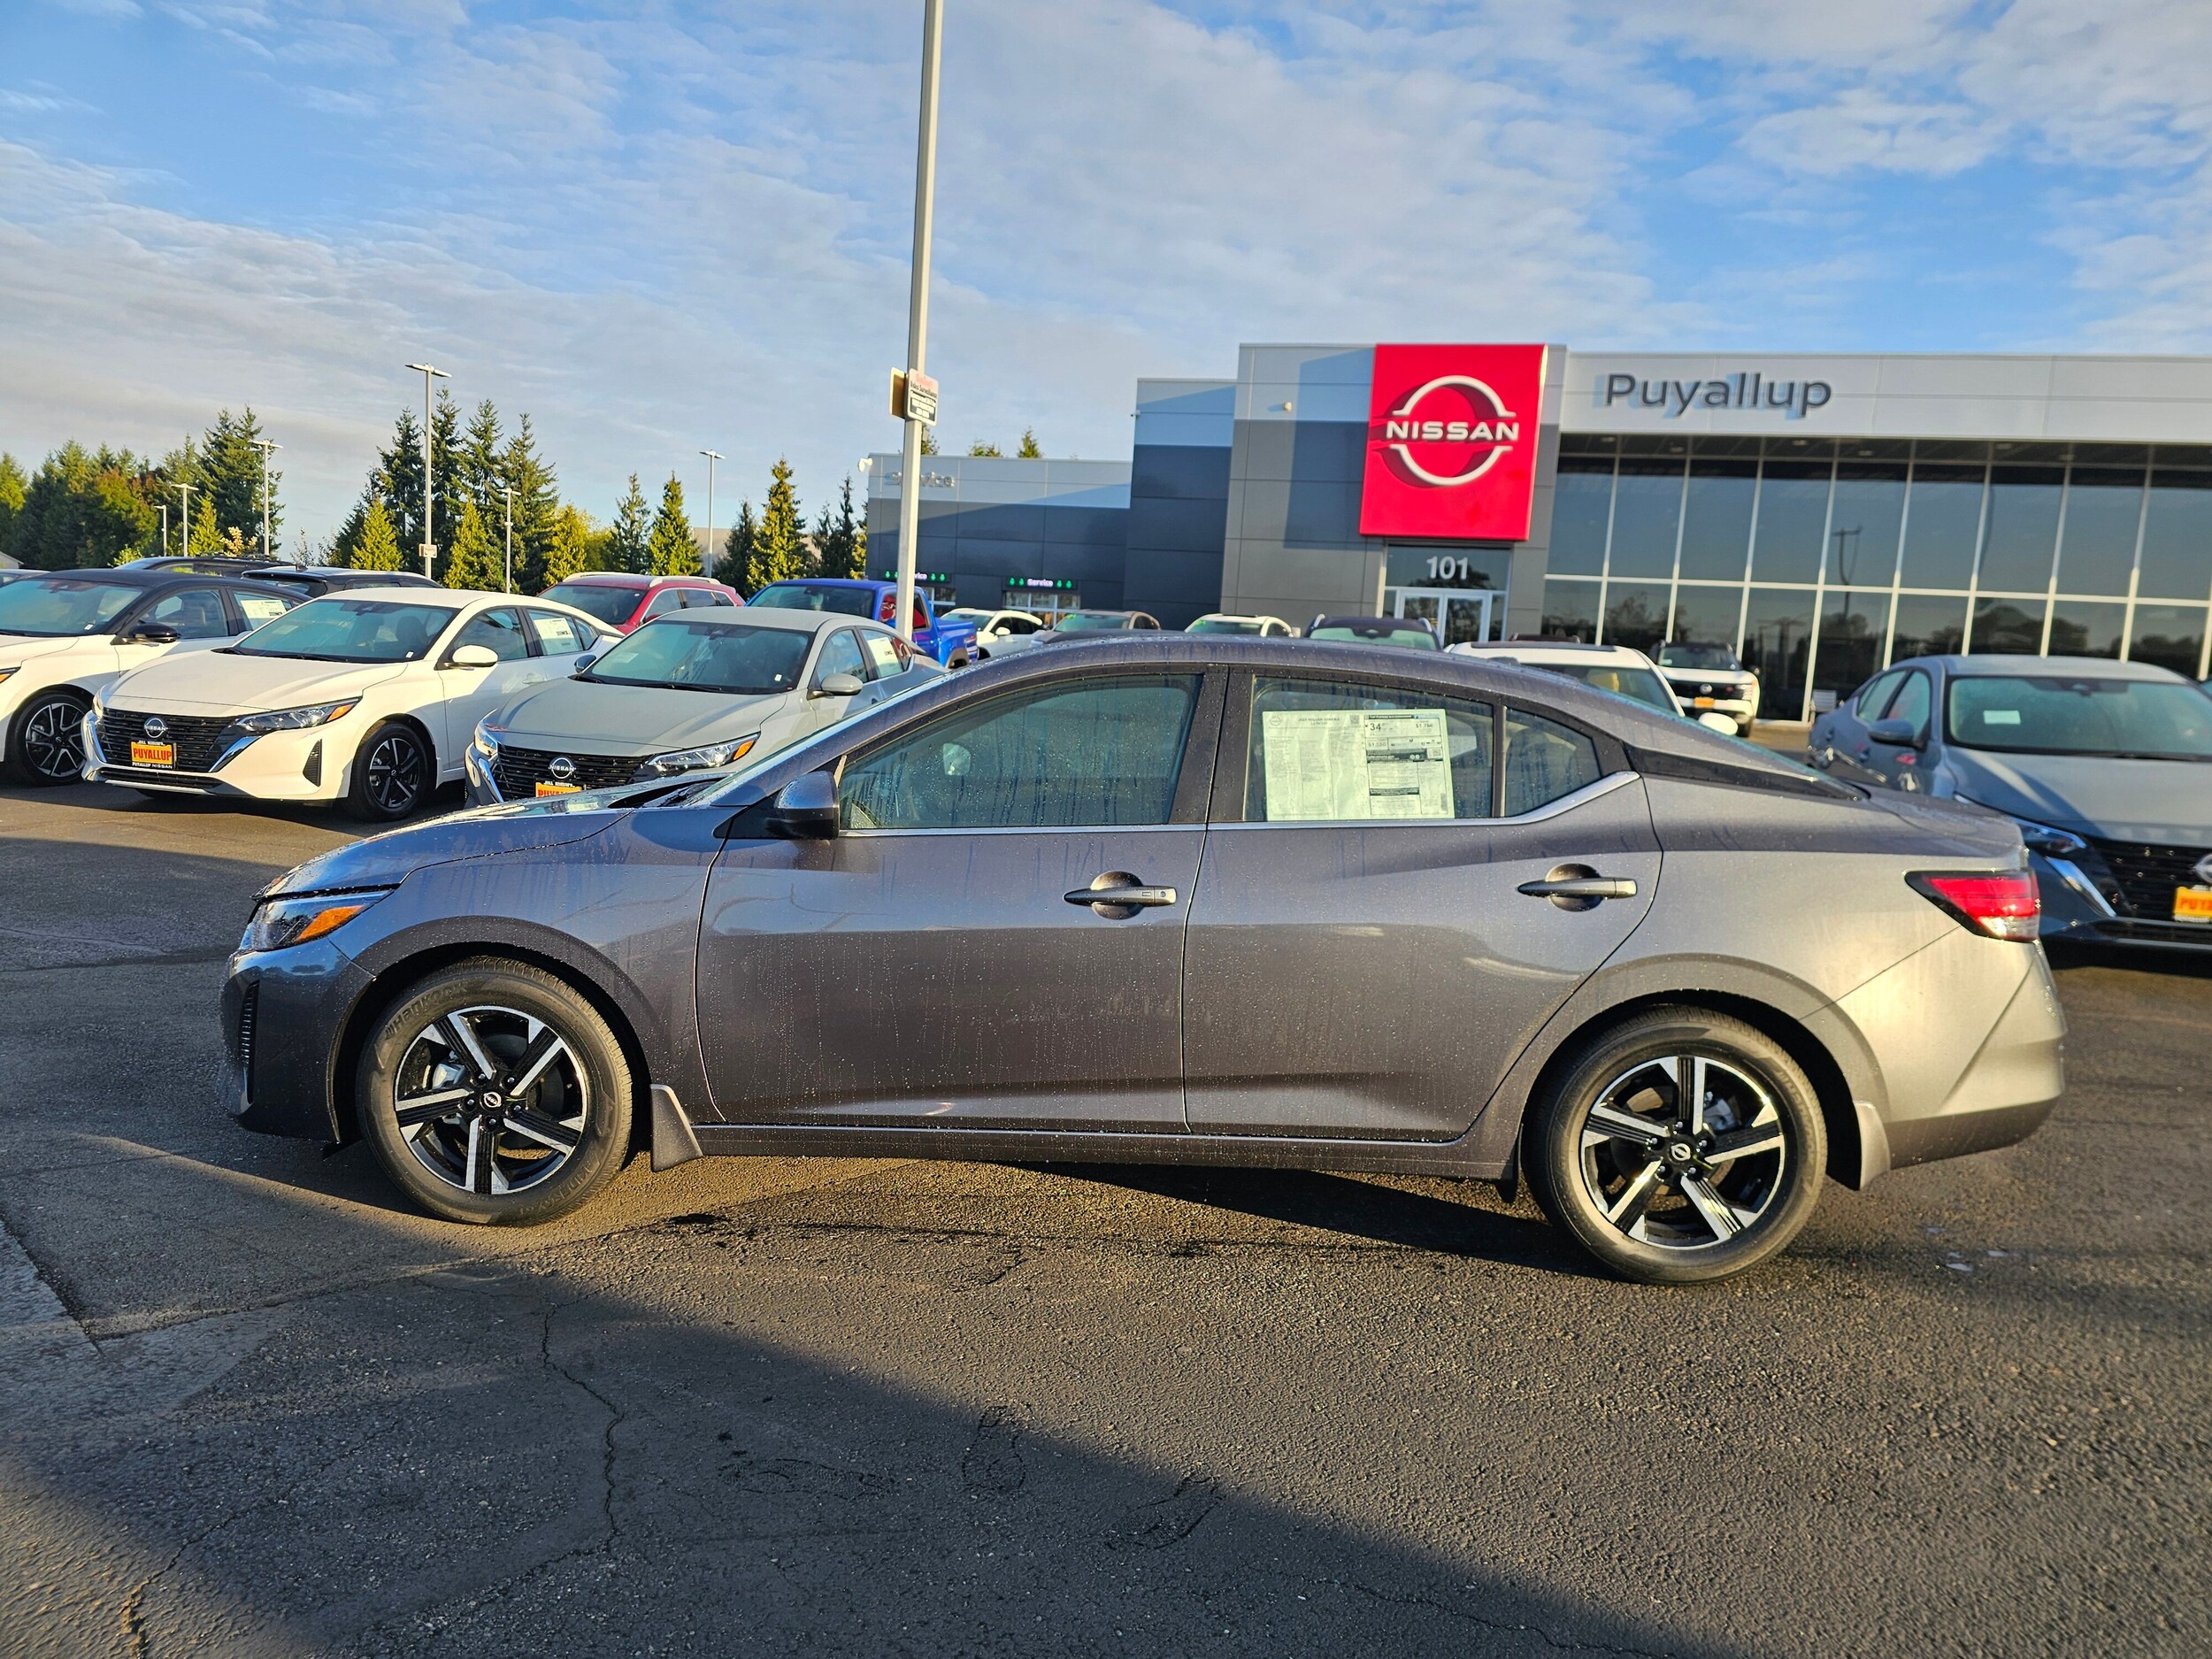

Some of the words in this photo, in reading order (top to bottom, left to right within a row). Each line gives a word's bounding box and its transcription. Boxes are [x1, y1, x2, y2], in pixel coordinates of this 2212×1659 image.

[1606, 372, 1832, 419] Puyallup
[1386, 420, 1520, 441] NISSAN
[1426, 556, 1469, 580] 101
[1027, 579, 1054, 588] Service
[133, 748, 172, 761] PUYALLUP
